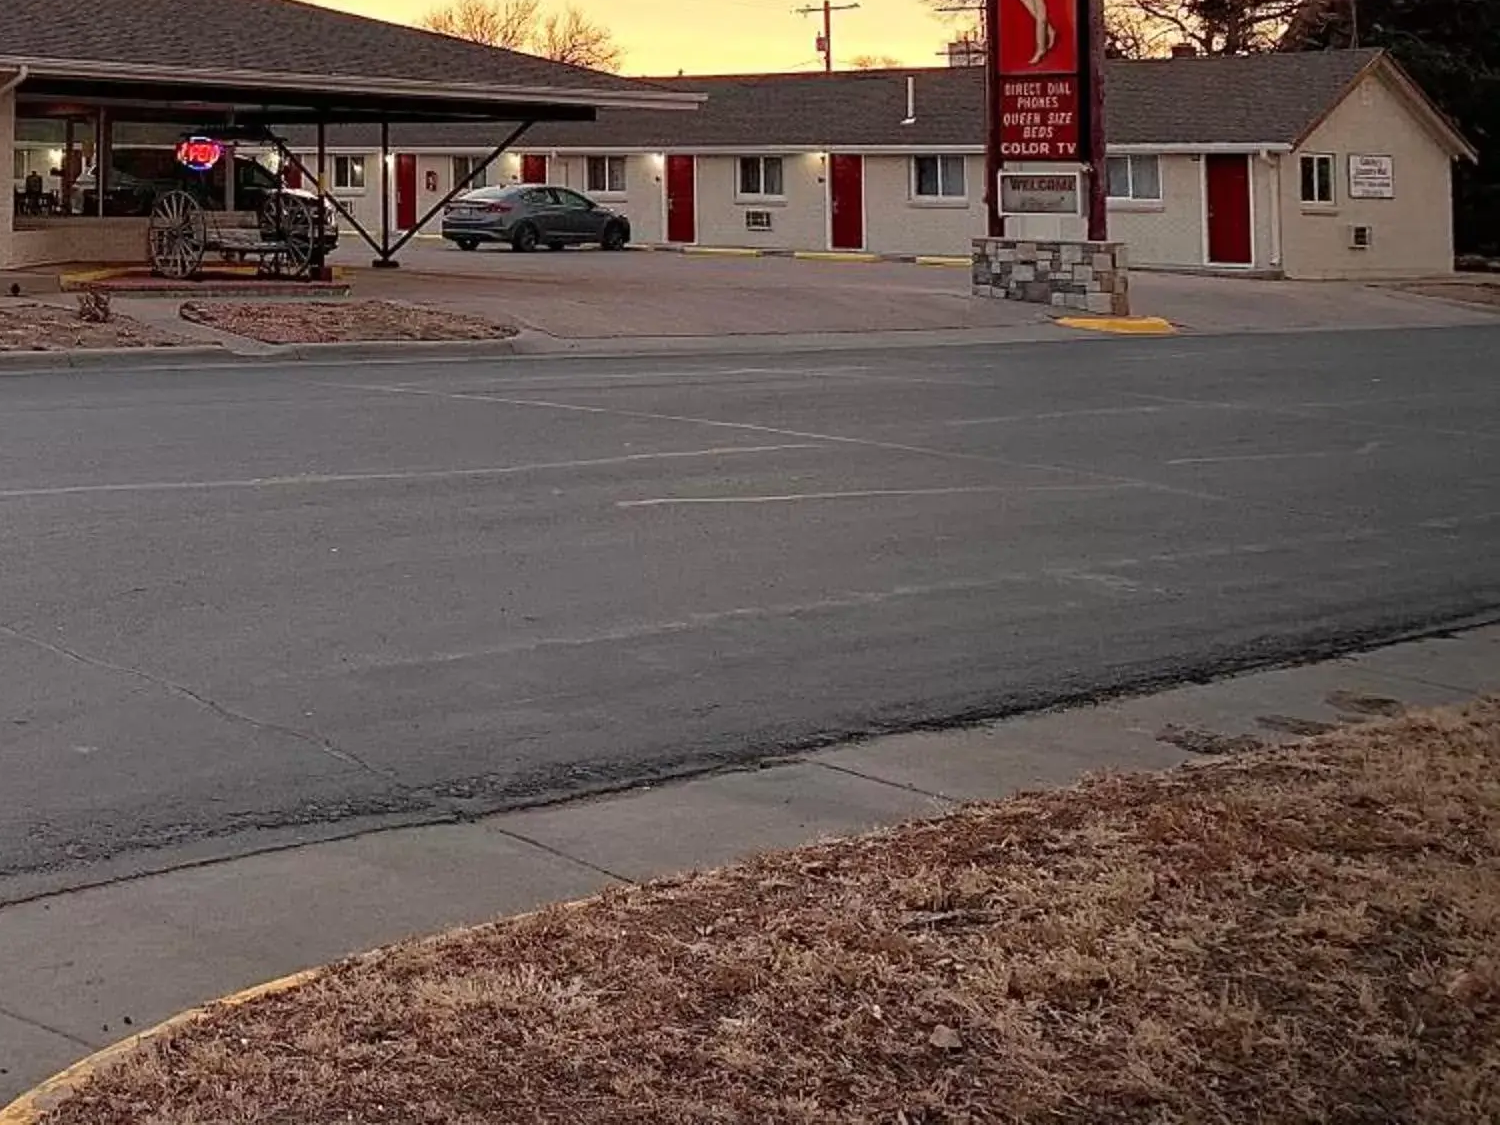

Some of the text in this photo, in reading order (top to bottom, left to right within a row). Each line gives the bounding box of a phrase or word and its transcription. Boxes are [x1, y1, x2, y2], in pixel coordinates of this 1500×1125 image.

[1004, 82, 1071, 95] DIRECT DIAL
[1017, 96, 1059, 109] PHONES
[1003, 112, 1073, 127] QUEEN SIZE
[1023, 126, 1054, 138] BEDS
[1001, 142, 1077, 155] COLOR TV
